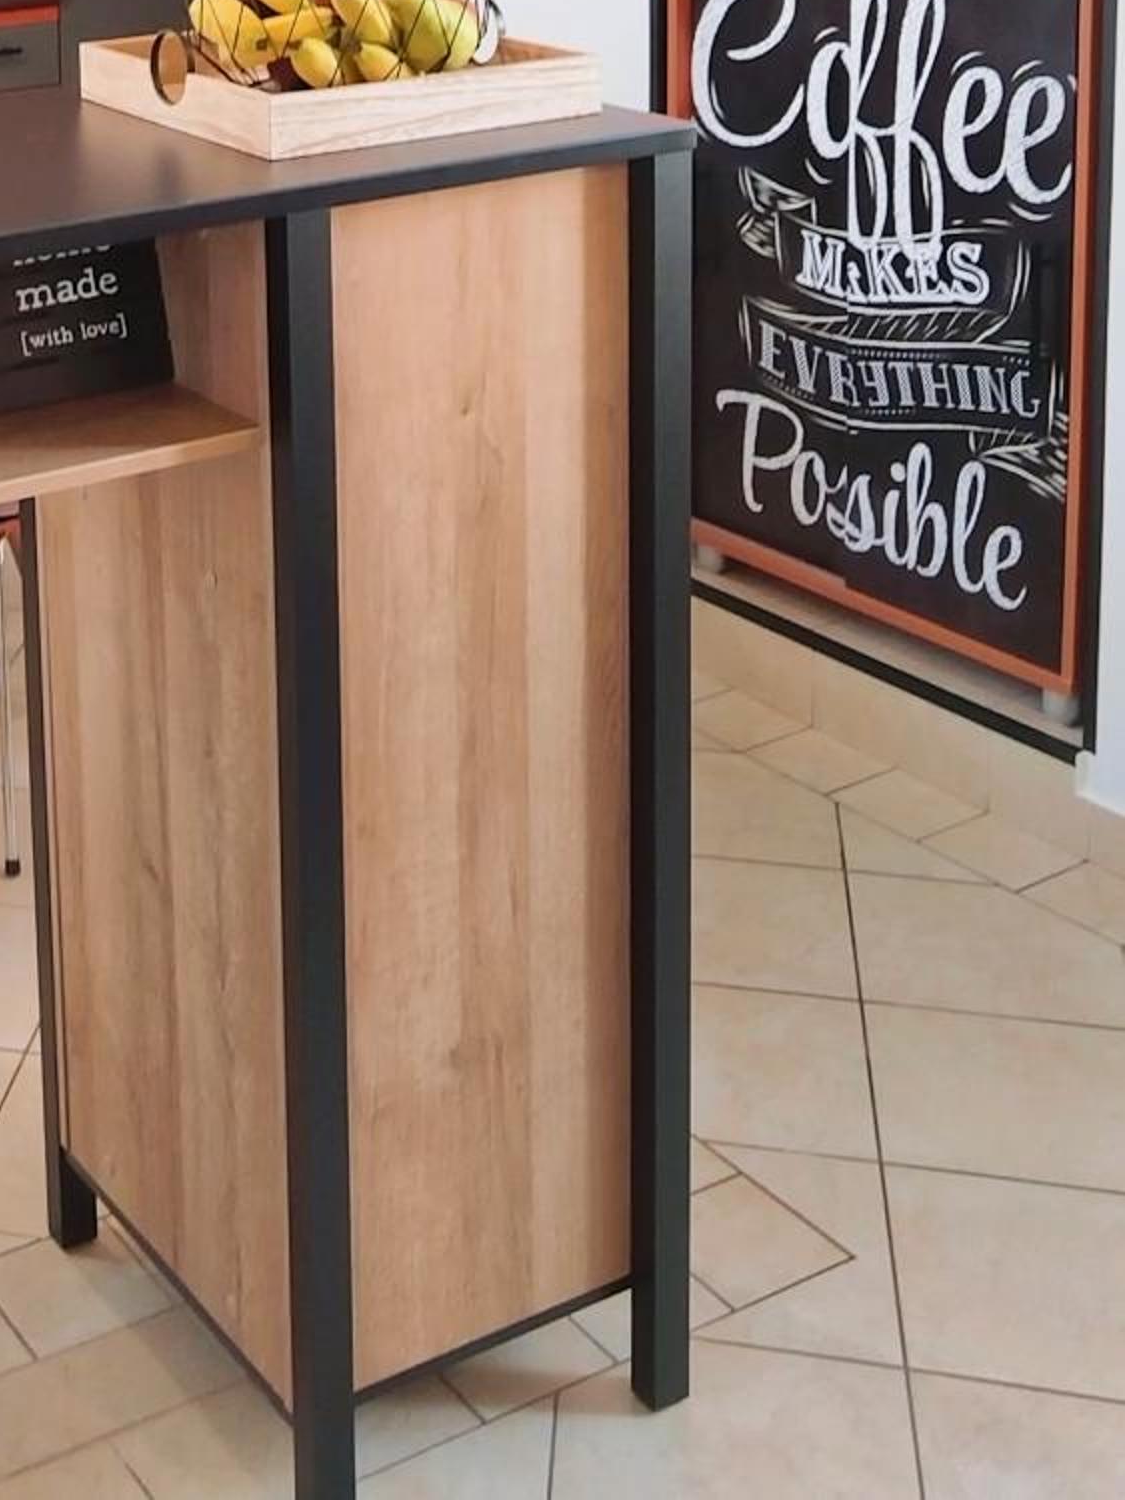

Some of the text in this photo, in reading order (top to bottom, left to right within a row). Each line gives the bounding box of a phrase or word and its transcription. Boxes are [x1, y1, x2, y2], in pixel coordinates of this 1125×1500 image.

[15, 267, 119, 312] made
[20, 312, 129, 357] [with love]
